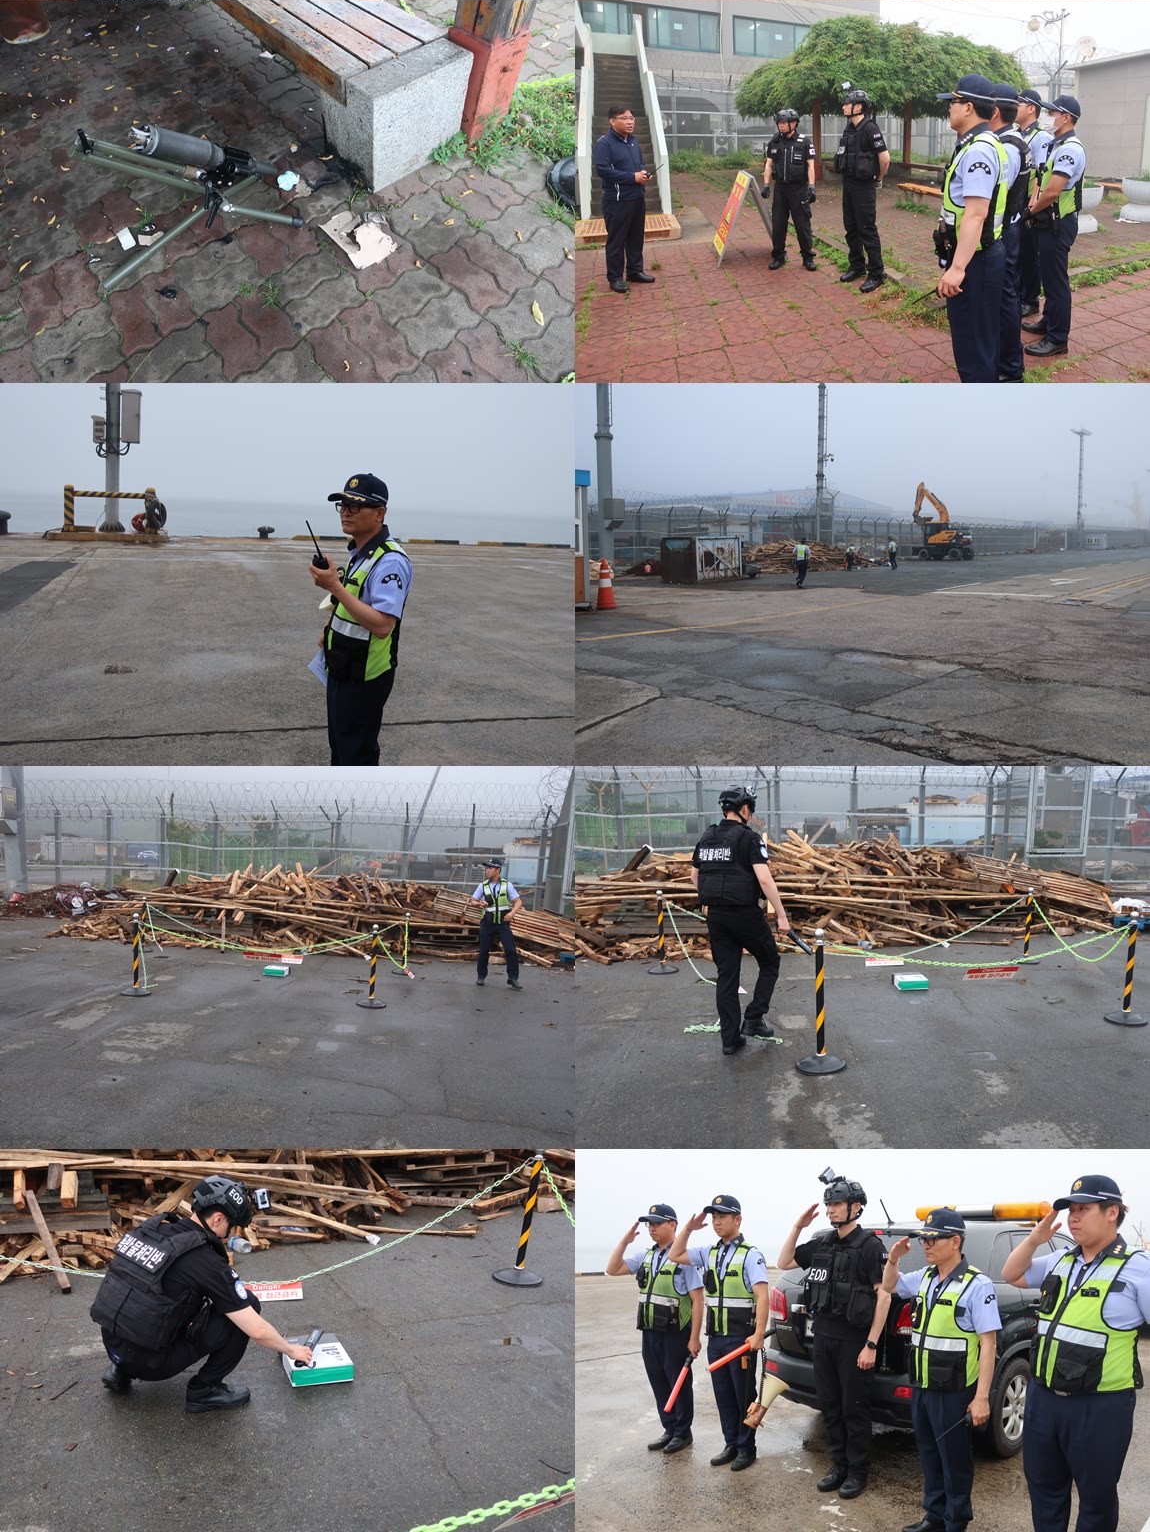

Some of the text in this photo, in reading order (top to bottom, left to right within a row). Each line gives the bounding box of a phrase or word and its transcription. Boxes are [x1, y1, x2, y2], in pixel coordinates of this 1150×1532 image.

[699, 847, 731, 862] 폭발물처리반
[229, 1188, 244, 1205] EOD
[116, 1233, 165, 1270] 폭발물처리반
[808, 1268, 828, 1281] EOD
[252, 1283, 282, 1291] Danger
[265, 1290, 298, 1299] 접근금지
